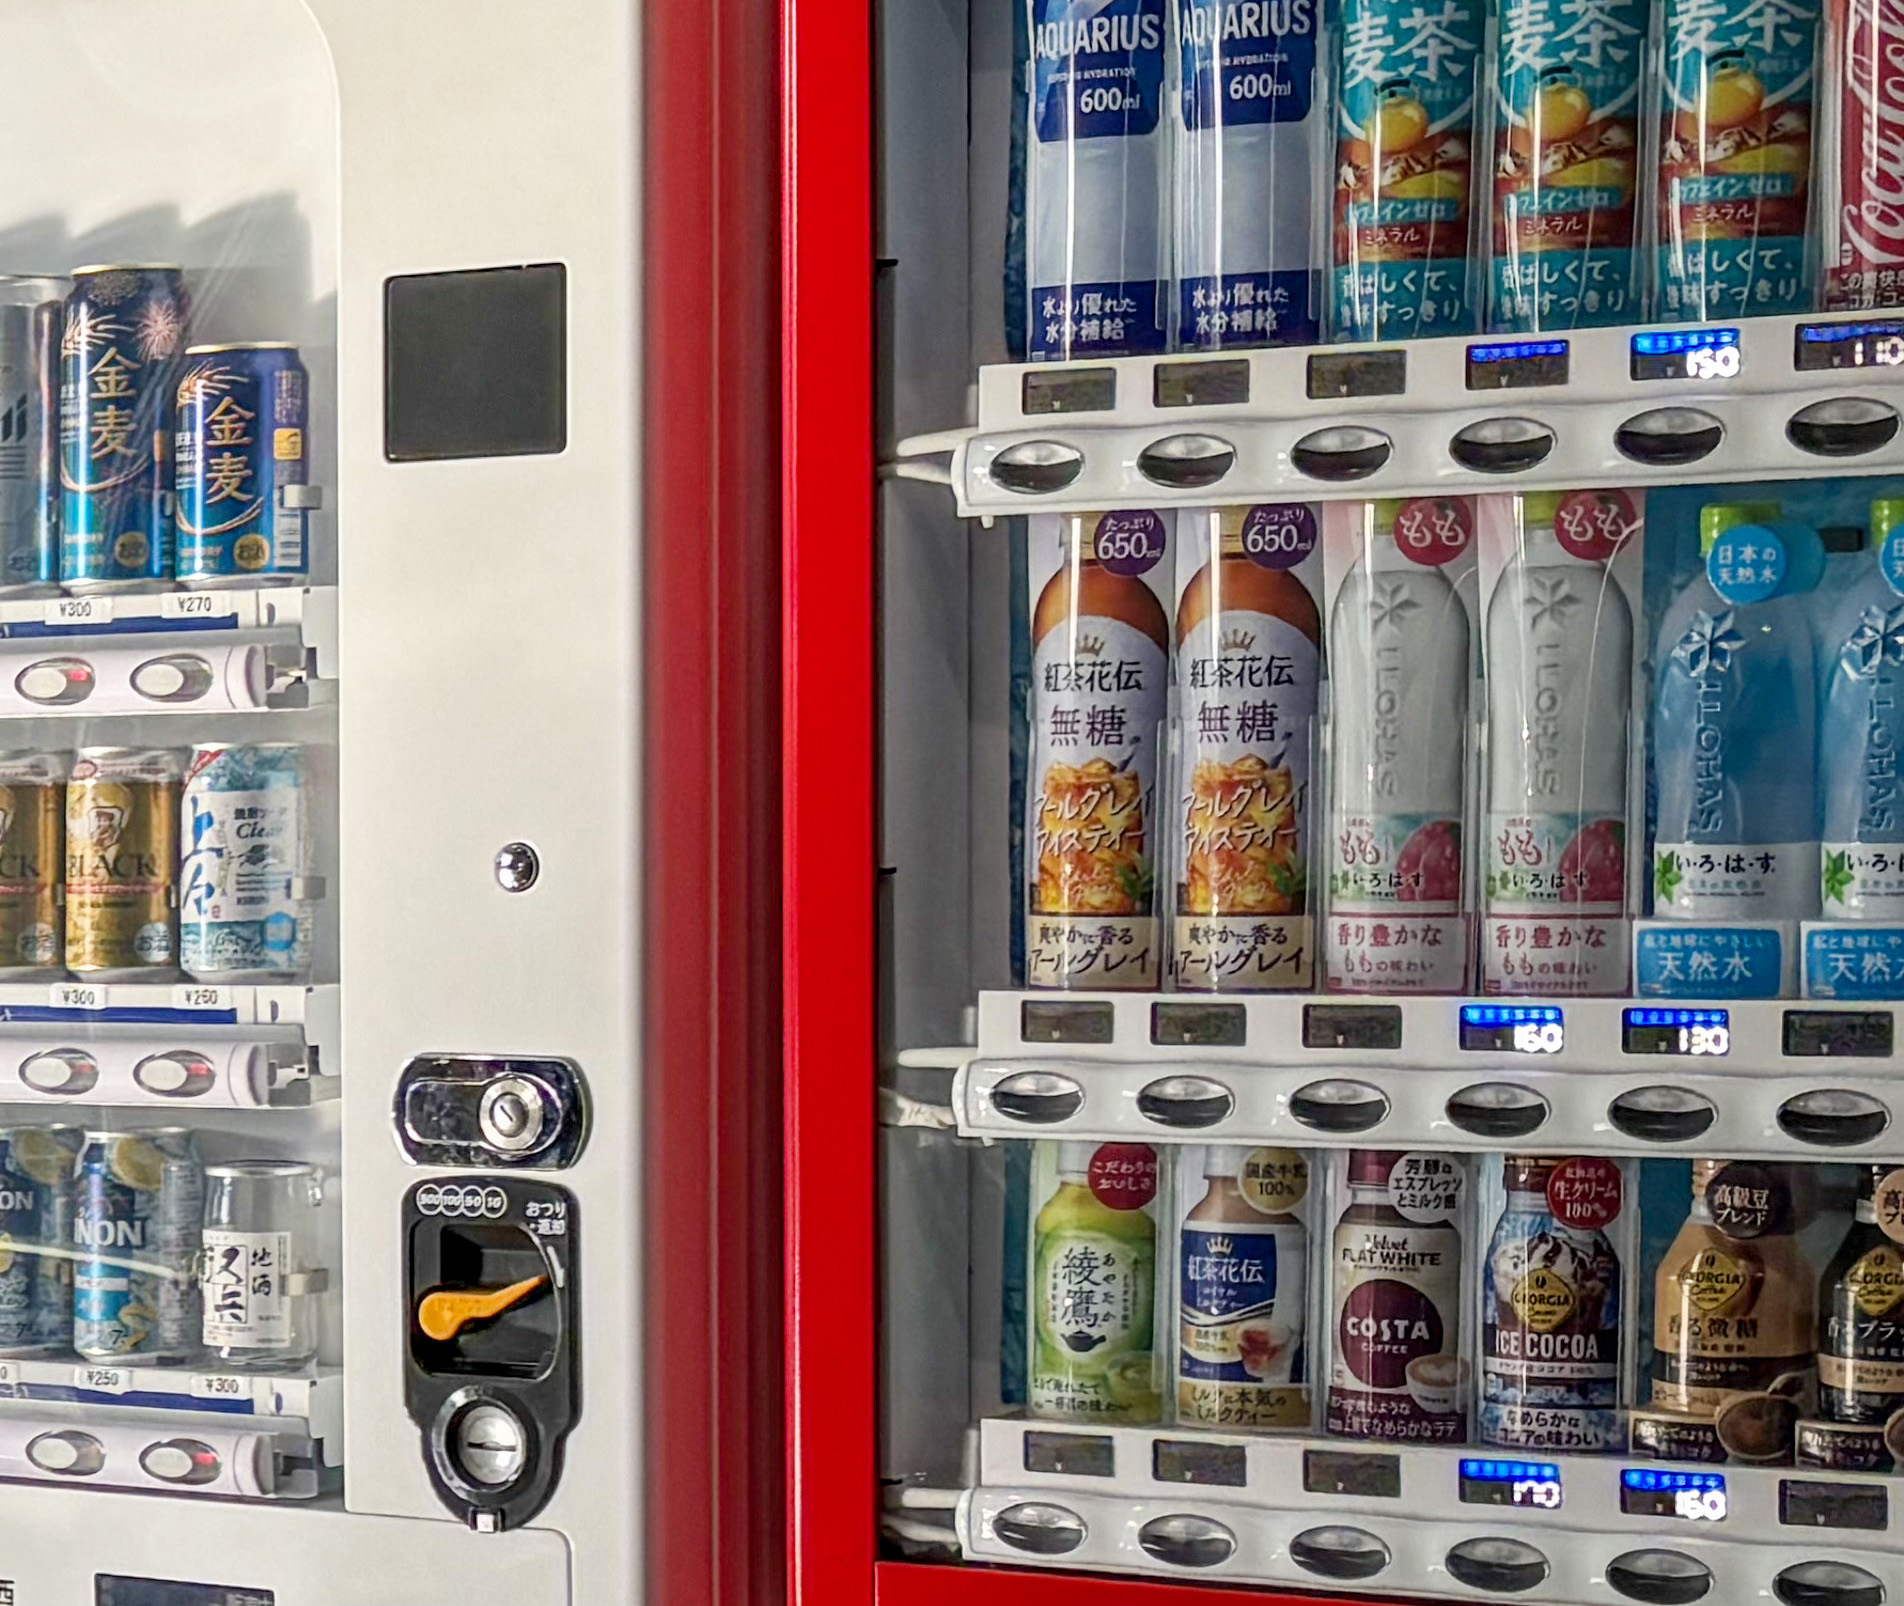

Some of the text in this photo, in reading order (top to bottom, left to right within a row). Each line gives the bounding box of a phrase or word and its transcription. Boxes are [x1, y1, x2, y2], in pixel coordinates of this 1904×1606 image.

[1182, 0, 1311, 46] AQUARIUS
[1036, 14, 1160, 59] AQUARIUS
[1343, 6, 1477, 89] 麦茶
[1500, 0, 1642, 76] 麦茶
[1229, 72, 1291, 100] 600ml
[1080, 86, 1140, 113] 600ml
[1694, 203, 1755, 222] ミネラル
[1364, 229, 1421, 246] ミネラル
[1523, 216, 1583, 235] ミネラル
[1195, 308, 1278, 334] 水分補給
[88, 346, 143, 460] 金麦
[205, 396, 256, 505] 金麦
[1105, 517, 1155, 532] たっぷり
[1253, 507, 1305, 523] たっぷり
[1562, 505, 1626, 542] もも
[1400, 510, 1465, 547] もも
[1717, 544, 1776, 565] 日本の
[60, 600, 92, 617] ¥300
[178, 596, 212, 613] ¥270
[1045, 658, 1143, 693] 紅茶花伝
[1190, 655, 1296, 689] 紅茶花伝
[1050, 704, 1127, 747] 無糖
[1197, 699, 1279, 744] 無糖
[1339, 830, 1380, 864] もも
[1497, 829, 1542, 865] もも
[68, 853, 159, 878] BLACK
[1189, 922, 1288, 947] 爽やかに香る
[1338, 923, 1442, 947] 香り豊かな
[1495, 924, 1606, 949] 香り豊かな
[1344, 949, 1434, 974] ももの味わい
[1502, 952, 1597, 976] ももの味わい
[1657, 951, 1753, 982] 天然水
[63, 990, 95, 1005] ¥300
[1393, 1177, 1462, 1192] エスプレッソ
[1555, 1183, 1618, 1201] 生クリーム
[464, 1195, 482, 1208] 50
[525, 1201, 566, 1219] おつり
[1717, 1208, 1767, 1226] ブレンド
[1188, 1255, 1265, 1283] 紅茶花伝
[1380, 1251, 1442, 1267] WHITE
[1061, 1246, 1102, 1328] 綾鷹
[1101, 1252, 1117, 1323] あやたか
[1346, 1317, 1430, 1341] COSTA
[1495, 1328, 1599, 1360] ICE COCOA
[86, 1370, 119, 1387] ¥250
[206, 1377, 240, 1394] ¥300
[1507, 1411, 1580, 1429] なめらかな
